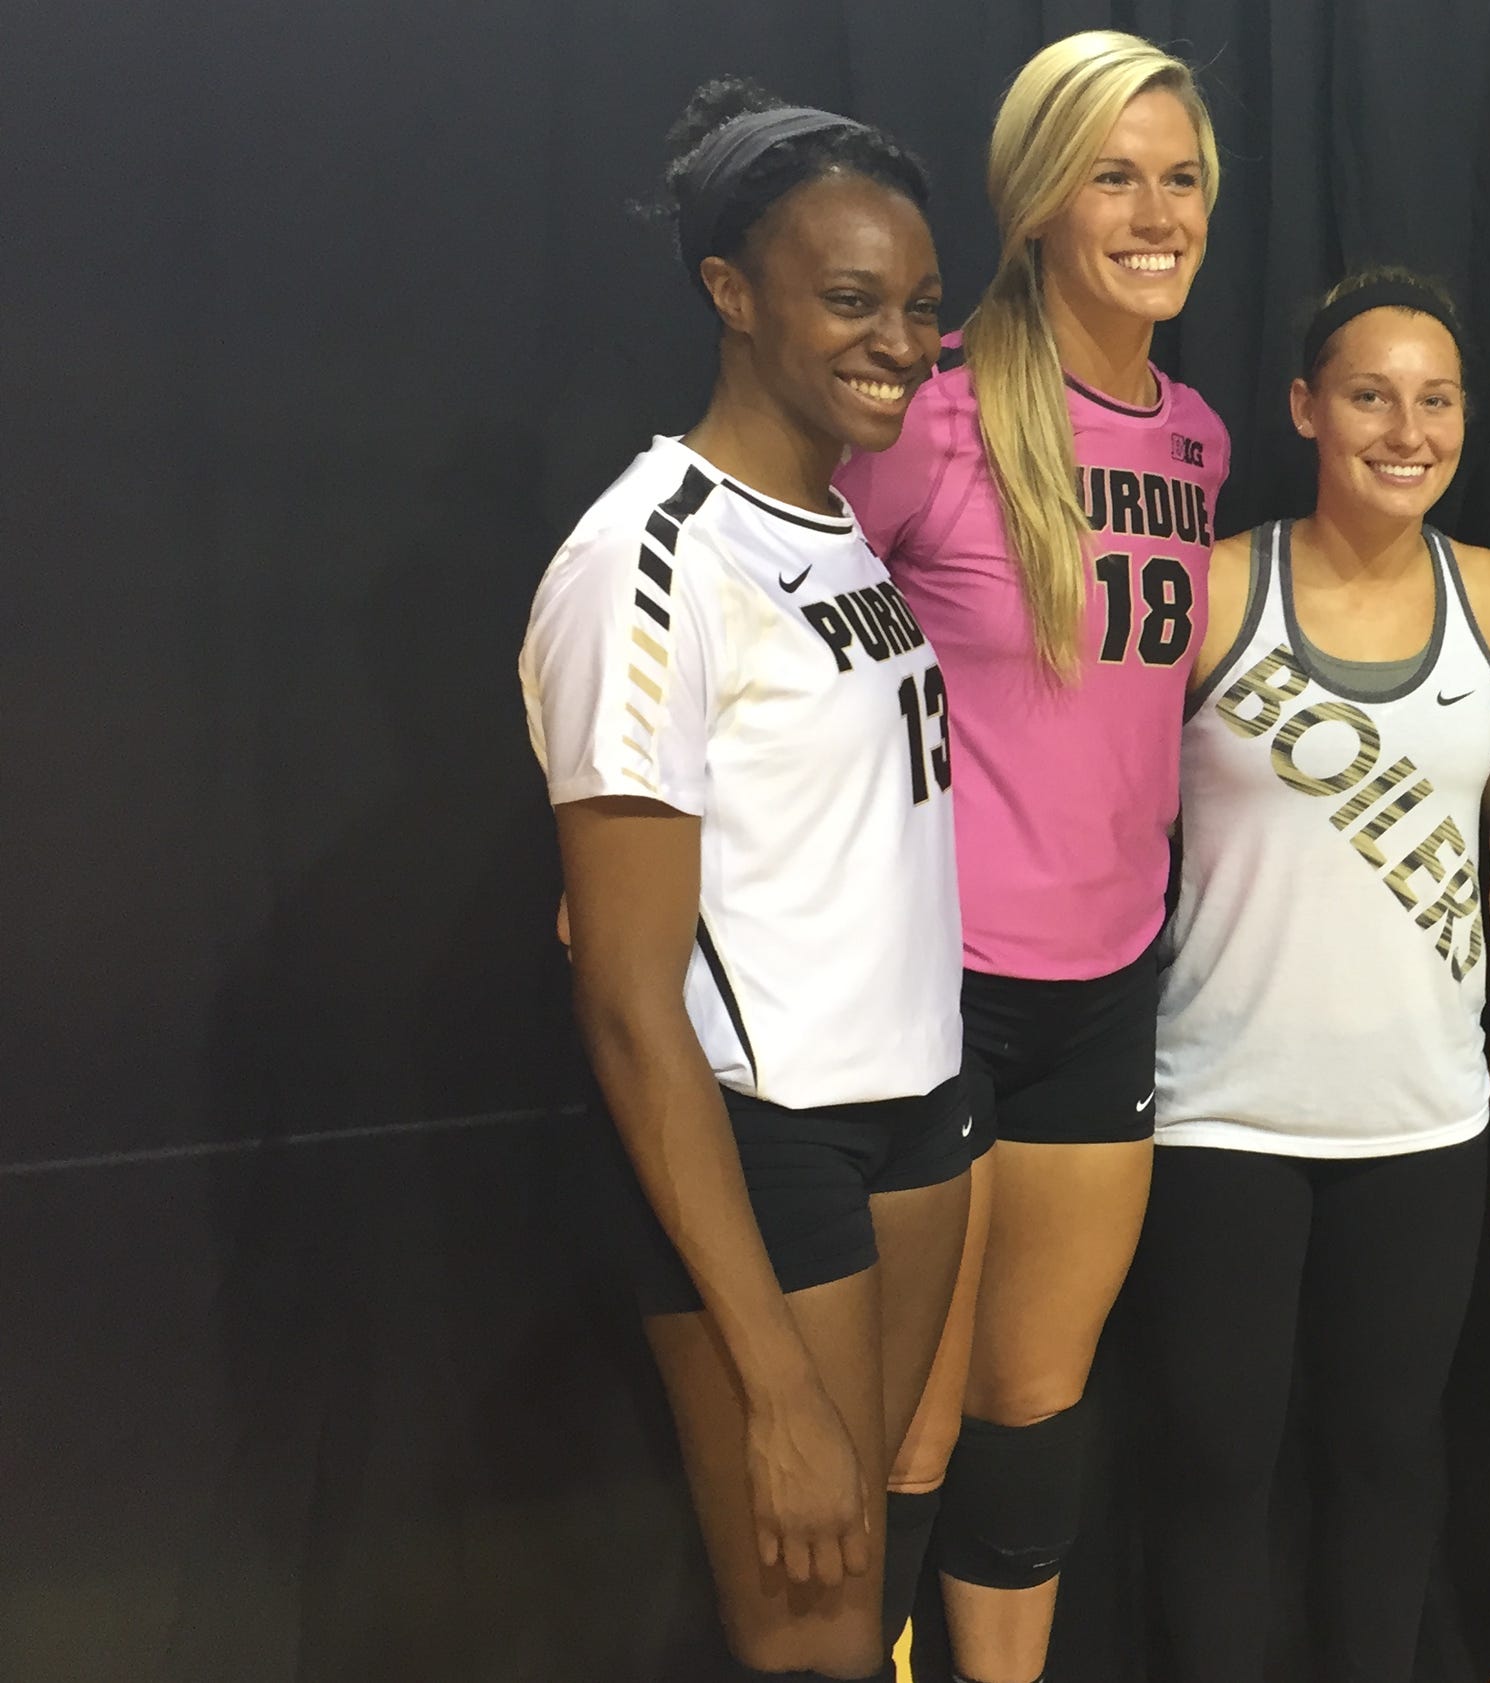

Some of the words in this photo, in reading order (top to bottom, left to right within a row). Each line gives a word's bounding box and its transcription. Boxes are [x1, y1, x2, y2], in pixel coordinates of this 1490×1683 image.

[1074, 465, 1211, 548] URDUE
[799, 580, 926, 674] PURD
[1094, 552, 1194, 668] 18
[898, 664, 952, 808] 13
